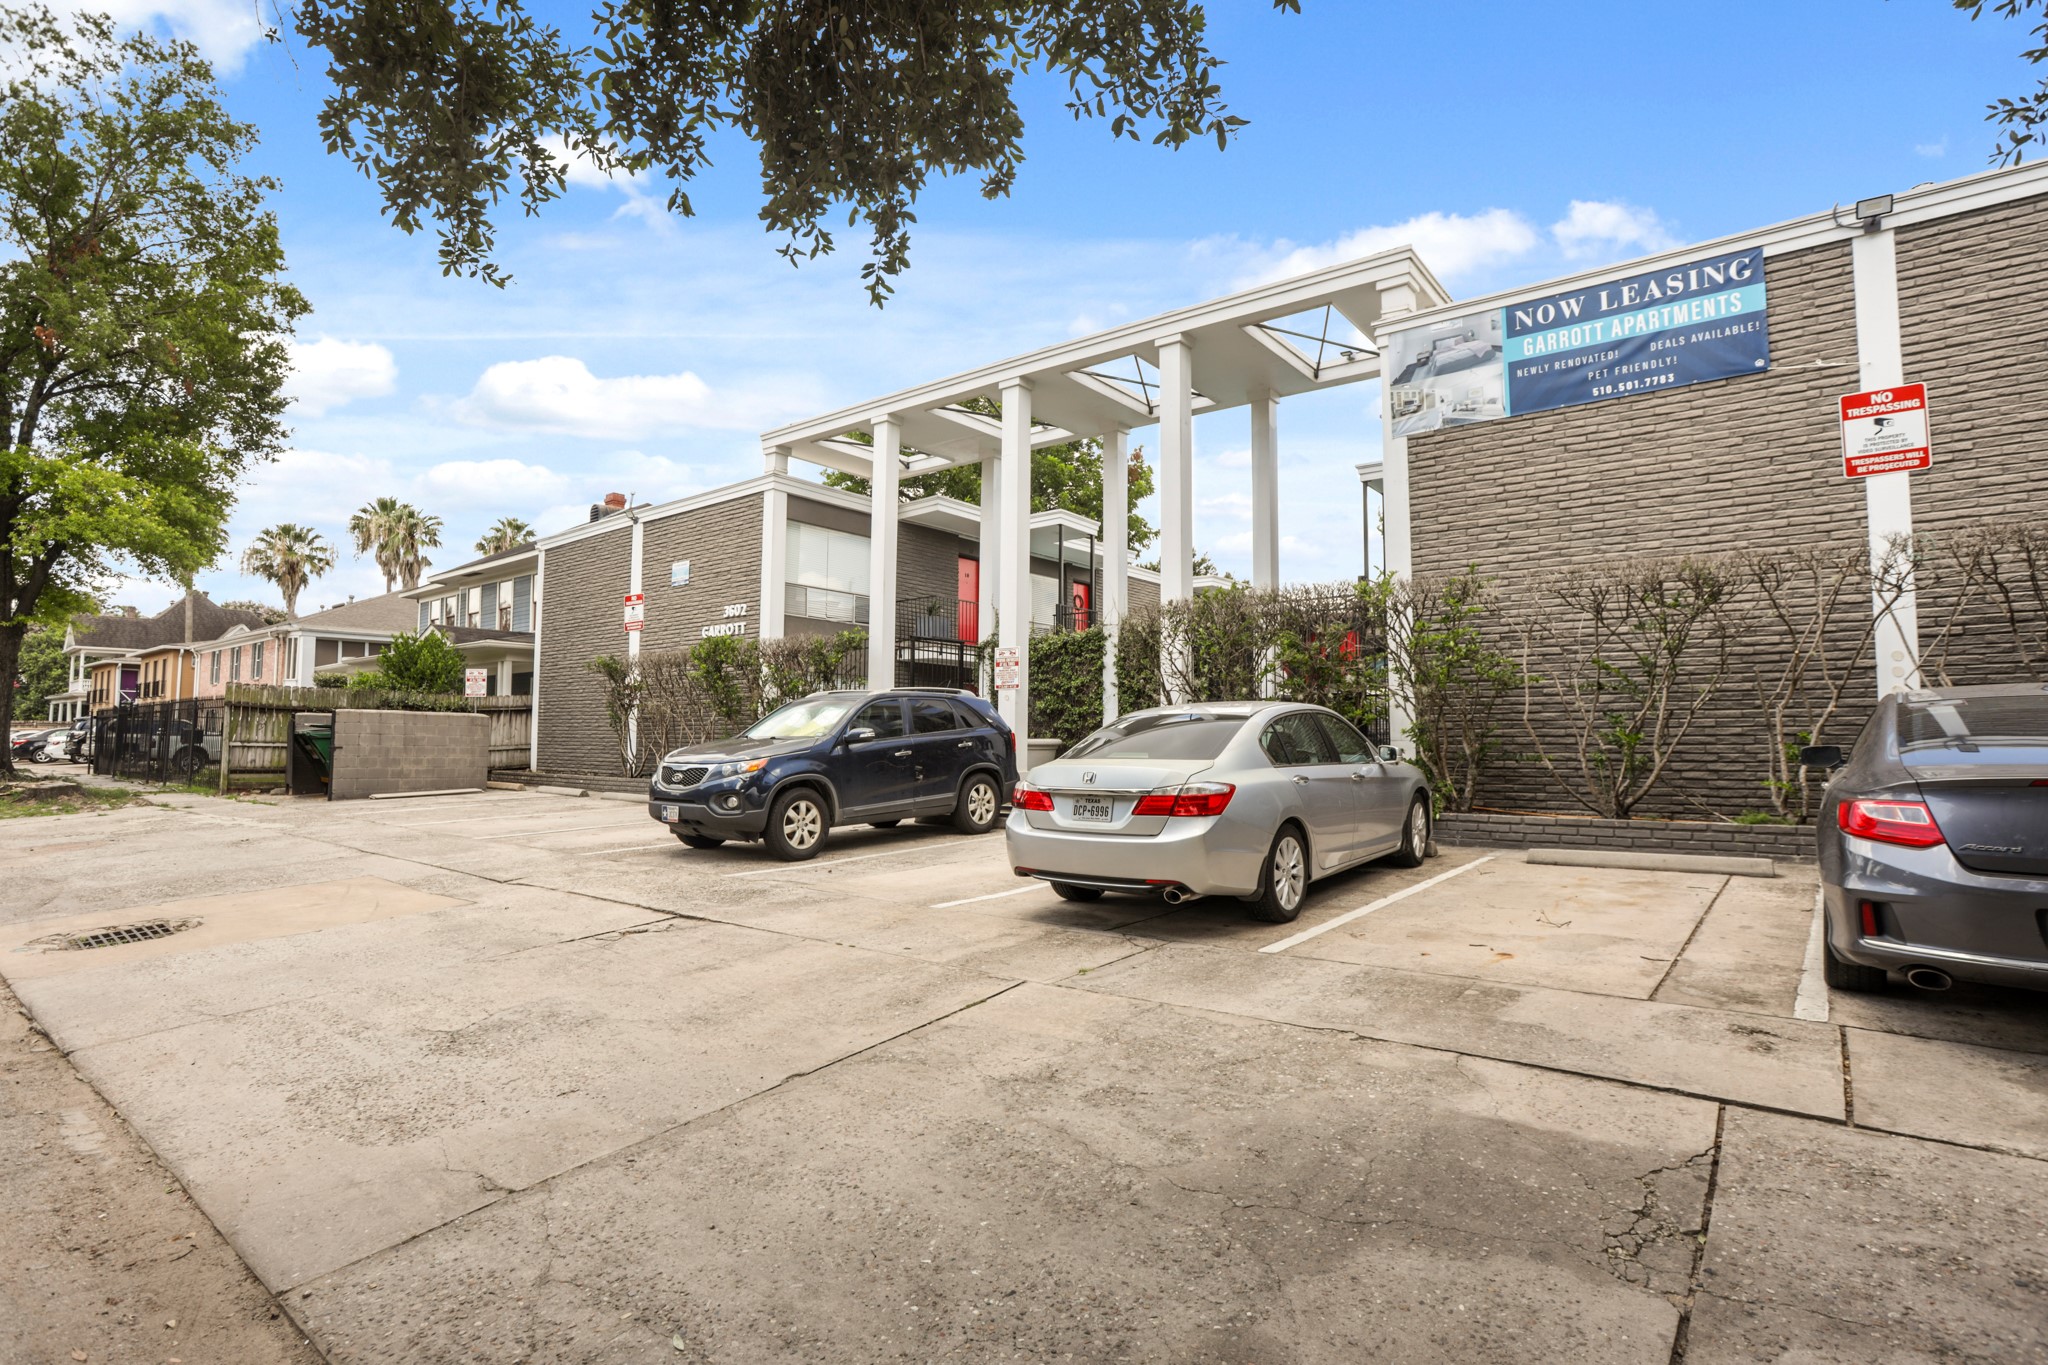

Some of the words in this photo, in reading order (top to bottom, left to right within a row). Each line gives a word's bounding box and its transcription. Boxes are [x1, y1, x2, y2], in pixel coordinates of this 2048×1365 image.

[1515, 296, 1585, 331] NOW
[1599, 257, 1753, 311] LEASING
[1523, 322, 1604, 356] GARROTT
[1611, 292, 1742, 337] APARTMENTS
[1517, 363, 1550, 378] NEWLY
[1554, 350, 1619, 370] RENOVATED!
[1650, 336, 1685, 351] DEALS
[1691, 321, 1760, 343] AVAILABLE!
[1588, 368, 1609, 381] PET
[1614, 355, 1678, 376] FRIENDLY!
[1592, 373, 1675, 397] 510.501.7783
[1870, 391, 1893, 405] NO
[1846, 398, 1921, 418] TRESPASSING
[1878, 432, 1906, 440] PROPERTY
[1851, 453, 1906, 466] TRESPASSERS
[1905, 450, 1926, 460] WILL
[1856, 465, 1869, 474] BE
[1869, 459, 1921, 472] PROSECUTED
[723, 603, 747, 618] 3602
[701, 622, 747, 638] GARROTT
[1958, 843, 2022, 853] Accord
